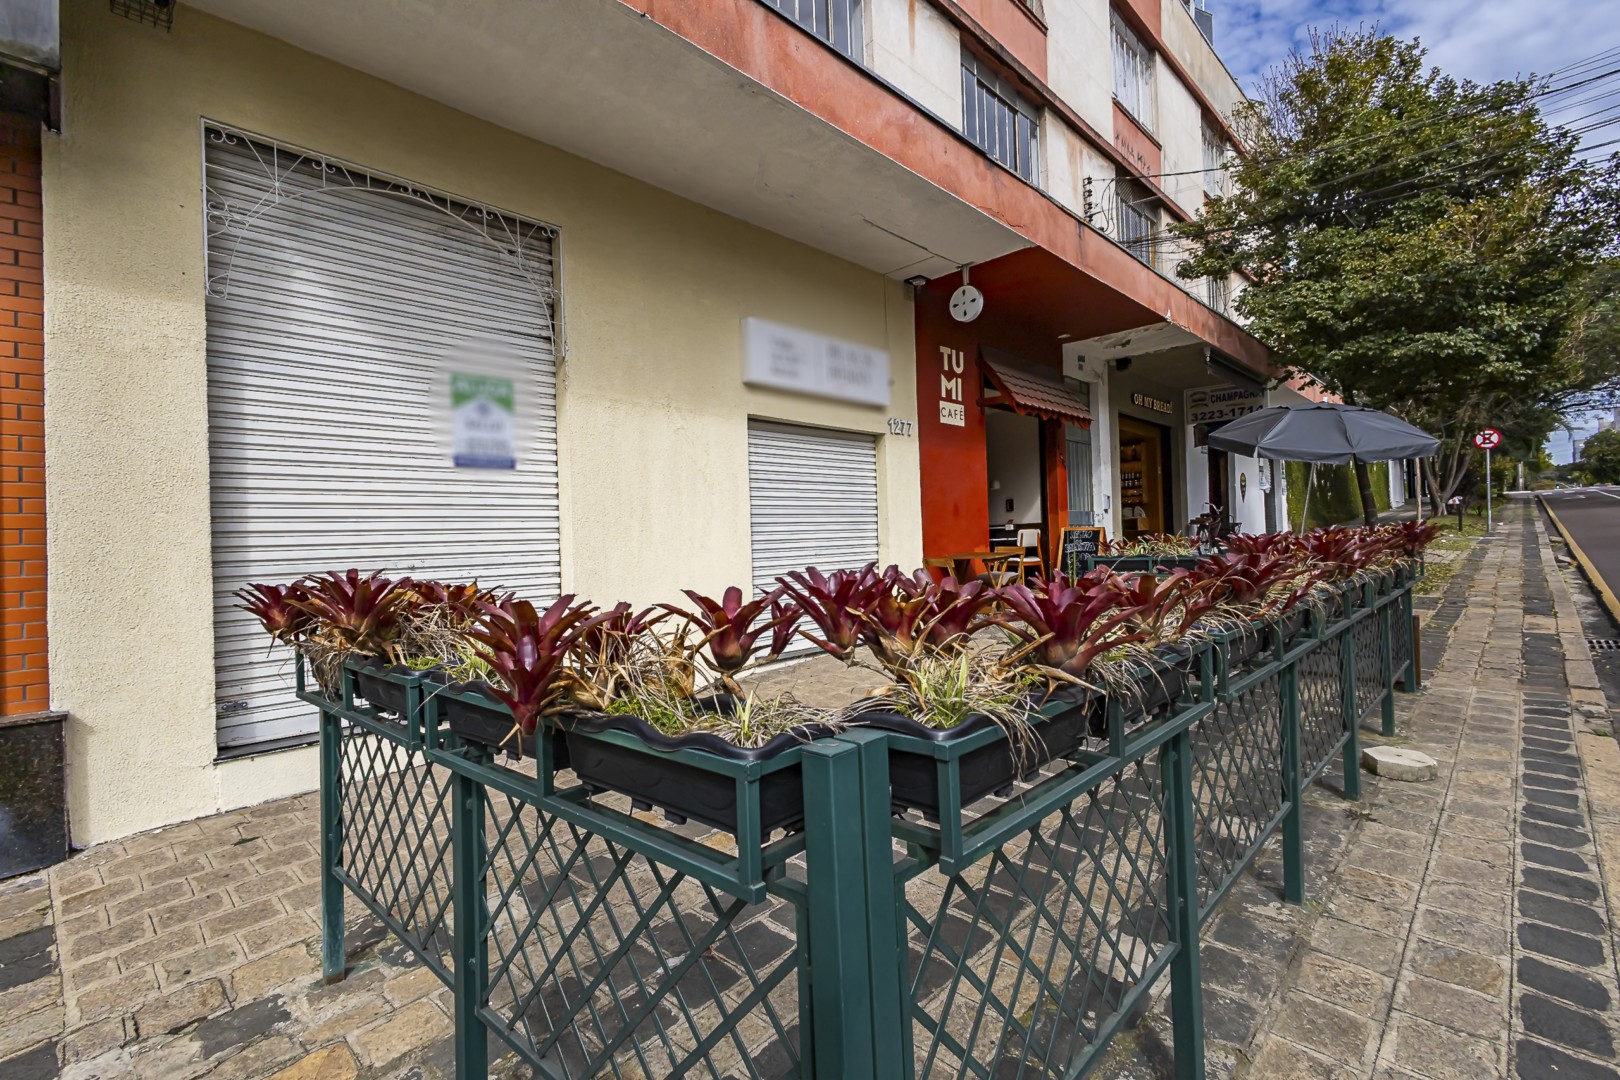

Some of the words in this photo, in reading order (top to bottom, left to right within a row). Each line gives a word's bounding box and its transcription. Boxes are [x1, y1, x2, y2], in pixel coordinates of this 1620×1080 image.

[939, 345, 964, 374] TU
[941, 373, 962, 401] MI
[1133, 393, 1143, 406] OH
[1144, 396, 1153, 409] MY
[940, 407, 964, 421] CAFÉ
[887, 417, 913, 437] 1277
